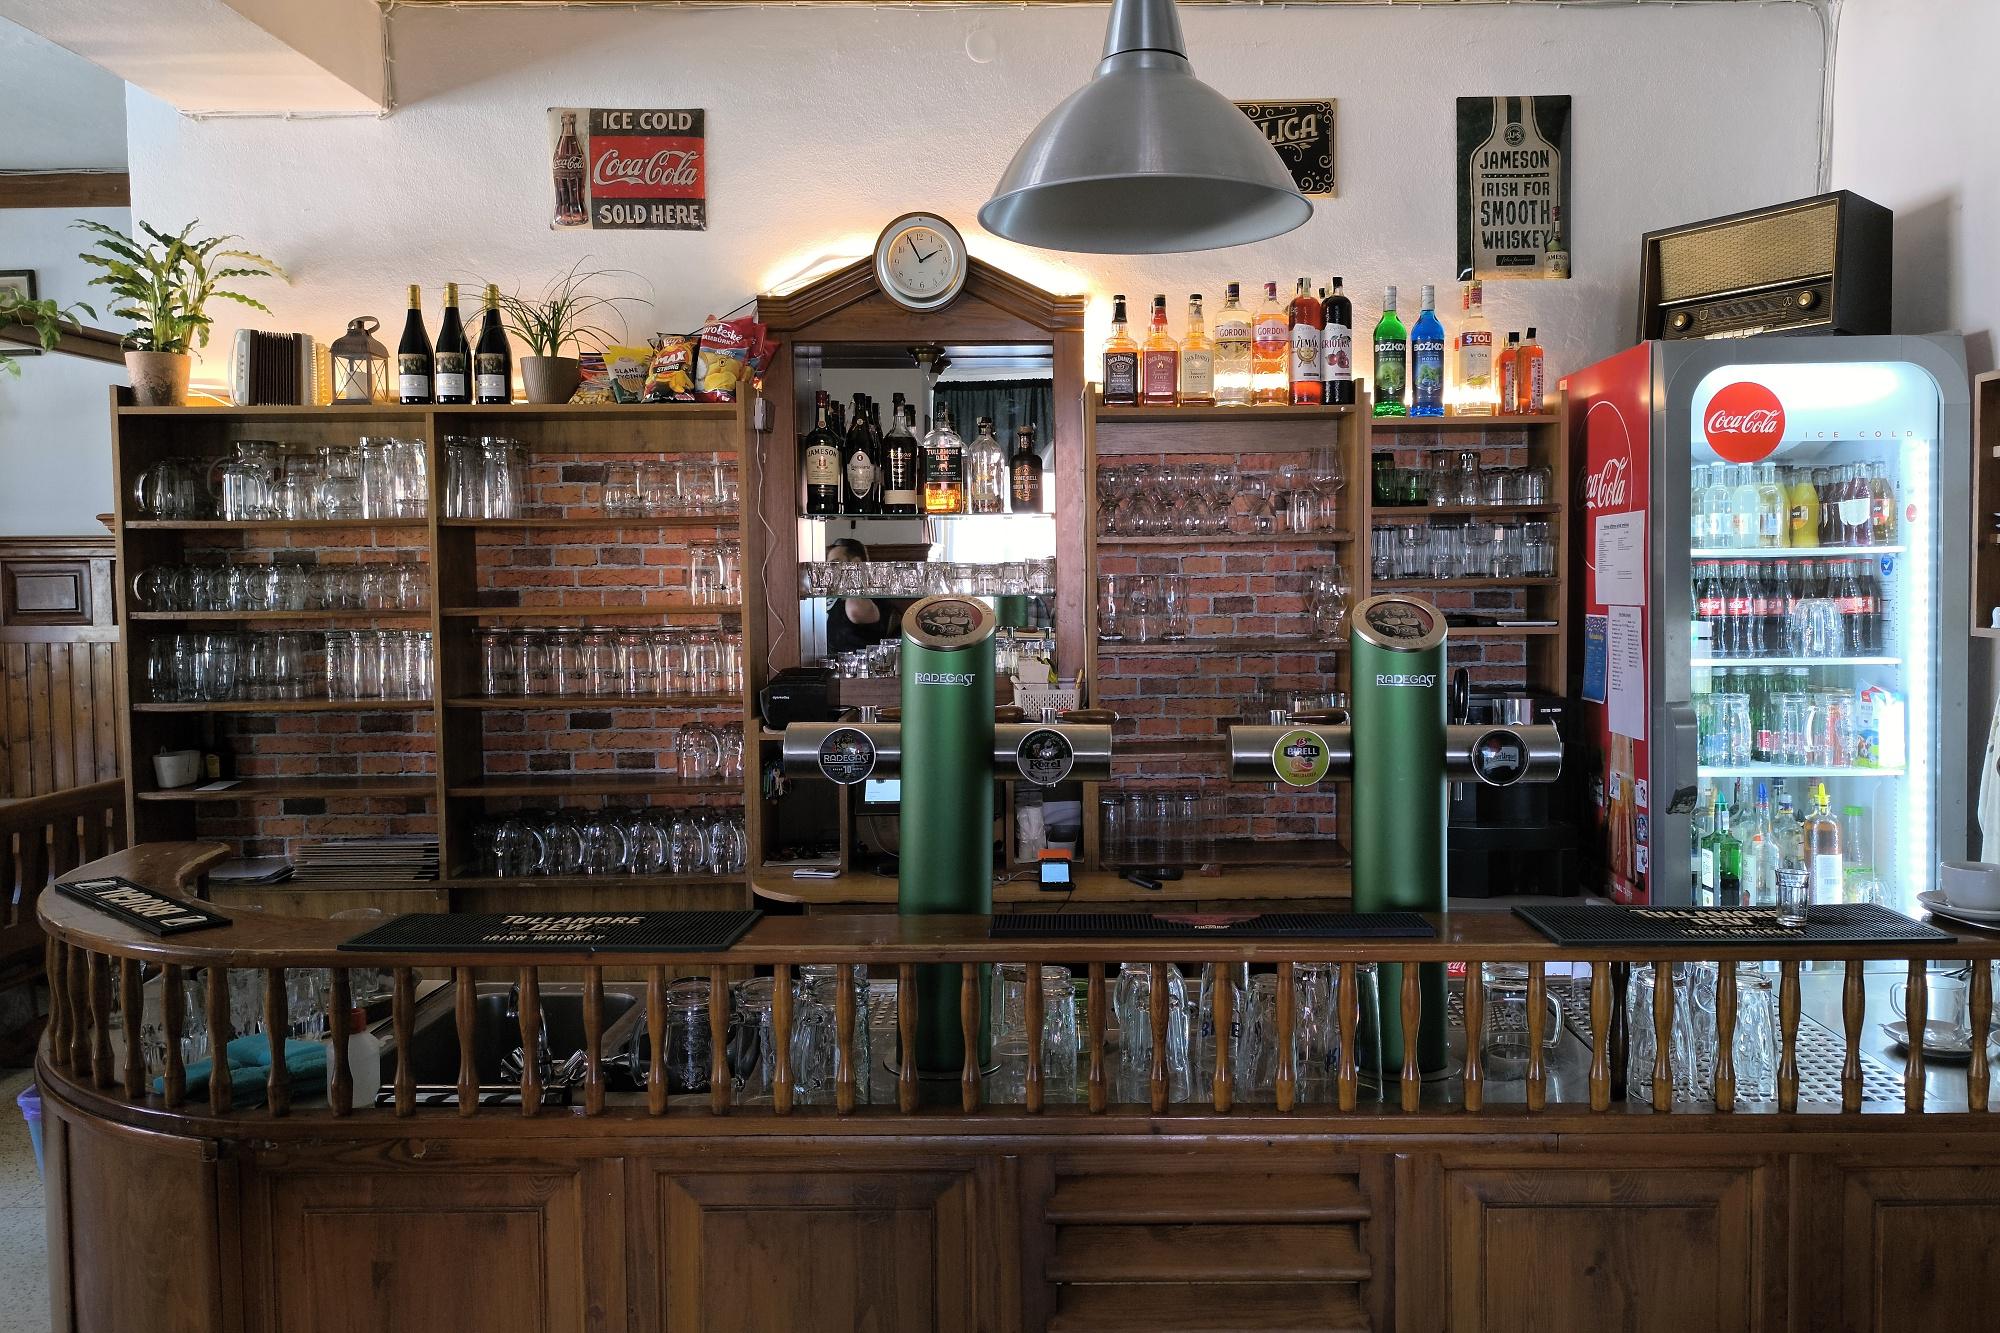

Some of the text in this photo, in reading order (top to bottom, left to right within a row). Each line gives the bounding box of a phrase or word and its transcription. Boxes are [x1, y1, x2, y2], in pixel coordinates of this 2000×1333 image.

[602, 112, 692, 130] ICE COLD
[1261, 114, 1318, 143] LICA
[553, 156, 584, 169] Coca-Cola
[1480, 150, 1549, 169] JAMESON
[593, 149, 700, 185] Coca-Cola
[1481, 182, 1549, 197] IRISH FOR
[601, 204, 699, 224] SOLD HERE
[1481, 200, 1550, 226] SMOOTH
[916, 233, 924, 241] 12
[1482, 230, 1549, 249] WHISKEY
[938, 244, 943, 252] 2
[919, 281, 925, 289] 6
[1466, 334, 1491, 343] STOLI
[655, 350, 686, 365] MAX
[657, 364, 679, 373] STRONG
[1707, 409, 1781, 434] Coca-Cola
[1805, 430, 1913, 439] ICE COLD
[808, 448, 837, 457] JAMESON
[914, 672, 976, 687] RADEGAST
[1376, 674, 1437, 688] RADEGAST
[1287, 747, 1318, 755] BIRELL
[823, 753, 870, 764] RADEGAST
[843, 765, 852, 774] 10
[1628, 909, 1778, 918] TULLAMORE
[501, 915, 646, 925] TULLAMORE
[1690, 918, 1754, 926] DEW
[528, 923, 592, 931] DEW
